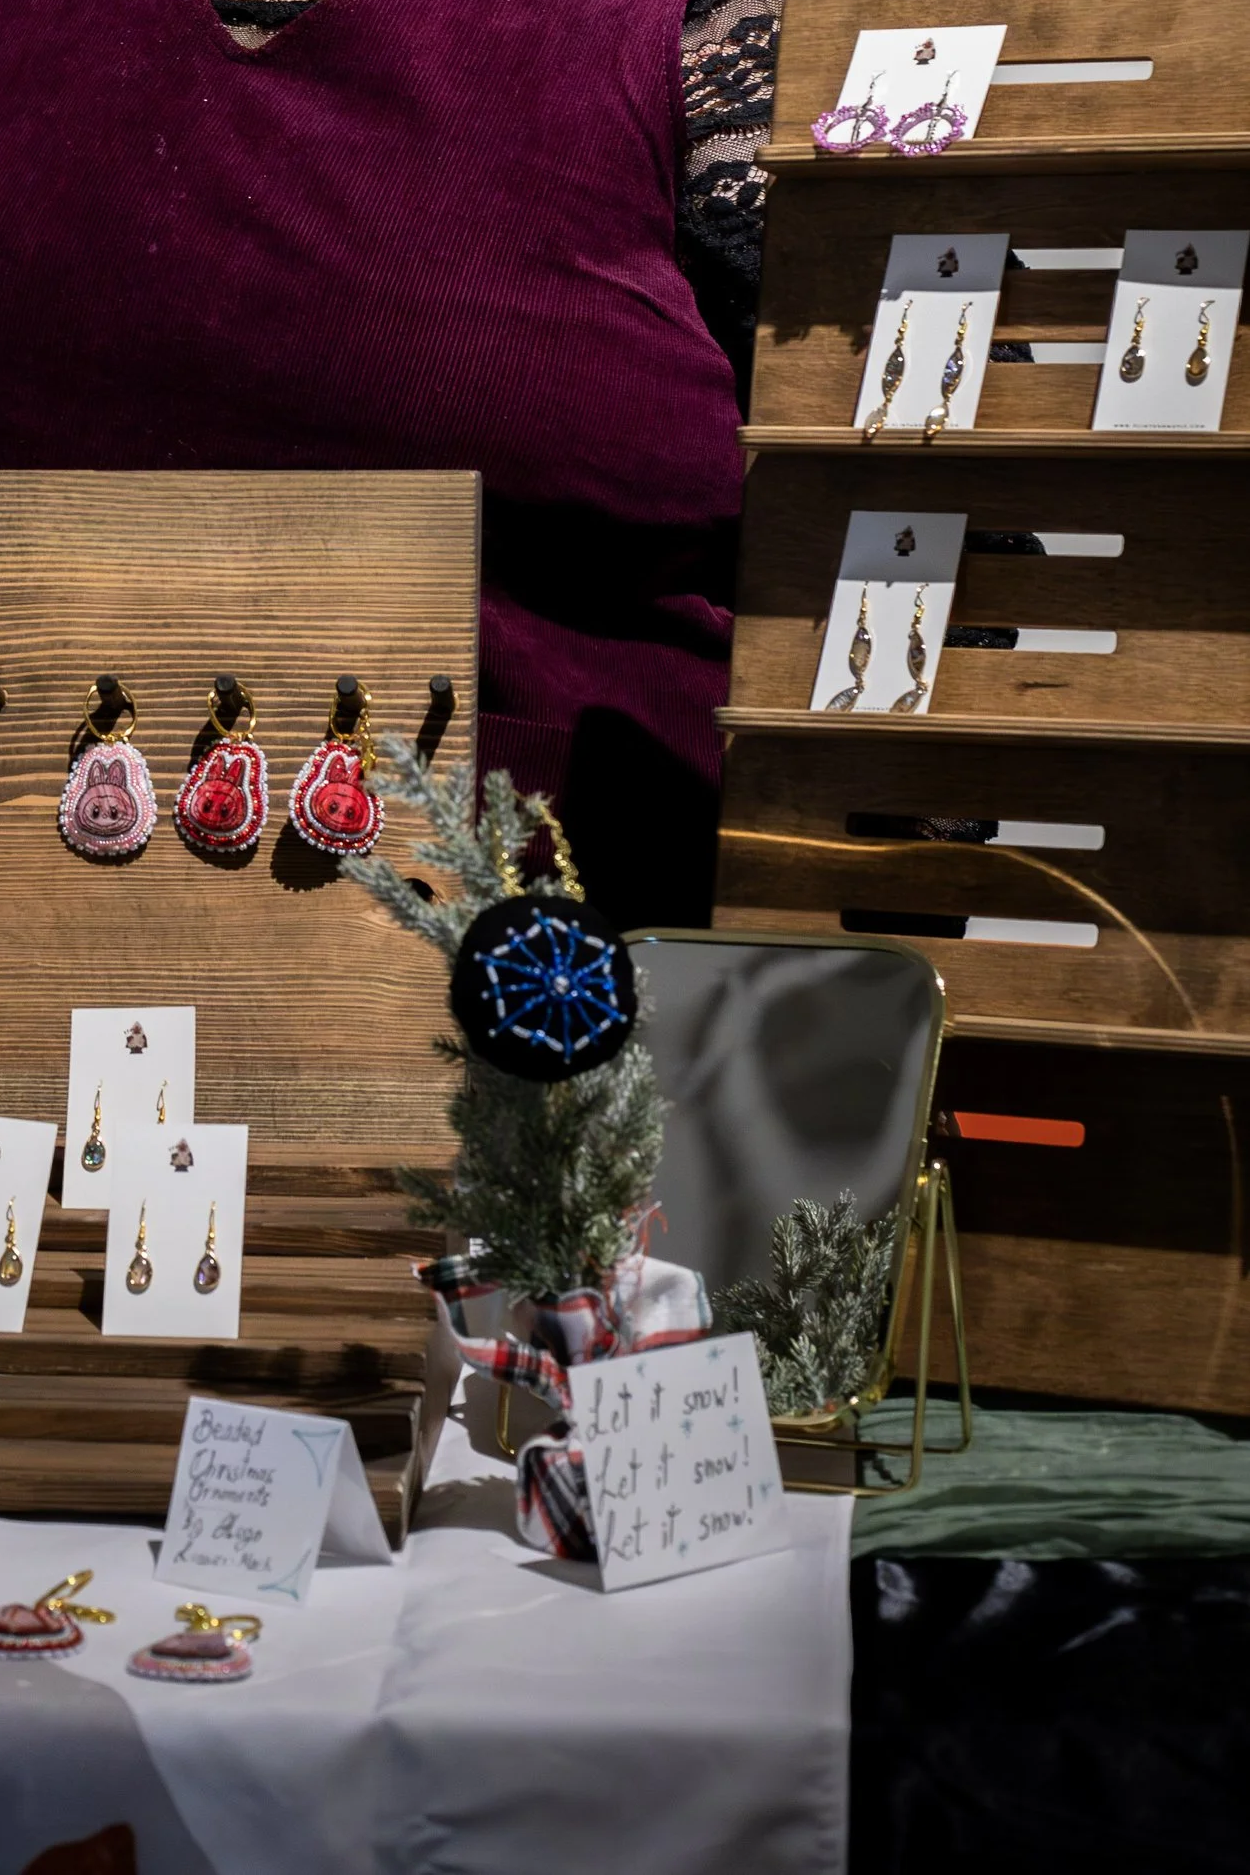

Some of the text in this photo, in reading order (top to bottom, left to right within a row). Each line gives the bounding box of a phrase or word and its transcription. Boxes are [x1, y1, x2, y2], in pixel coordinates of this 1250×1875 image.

[586, 1366, 739, 1442] Let it snow!
[595, 1434, 749, 1516] Let it snow!
[602, 1485, 753, 1570] Let it snow!
